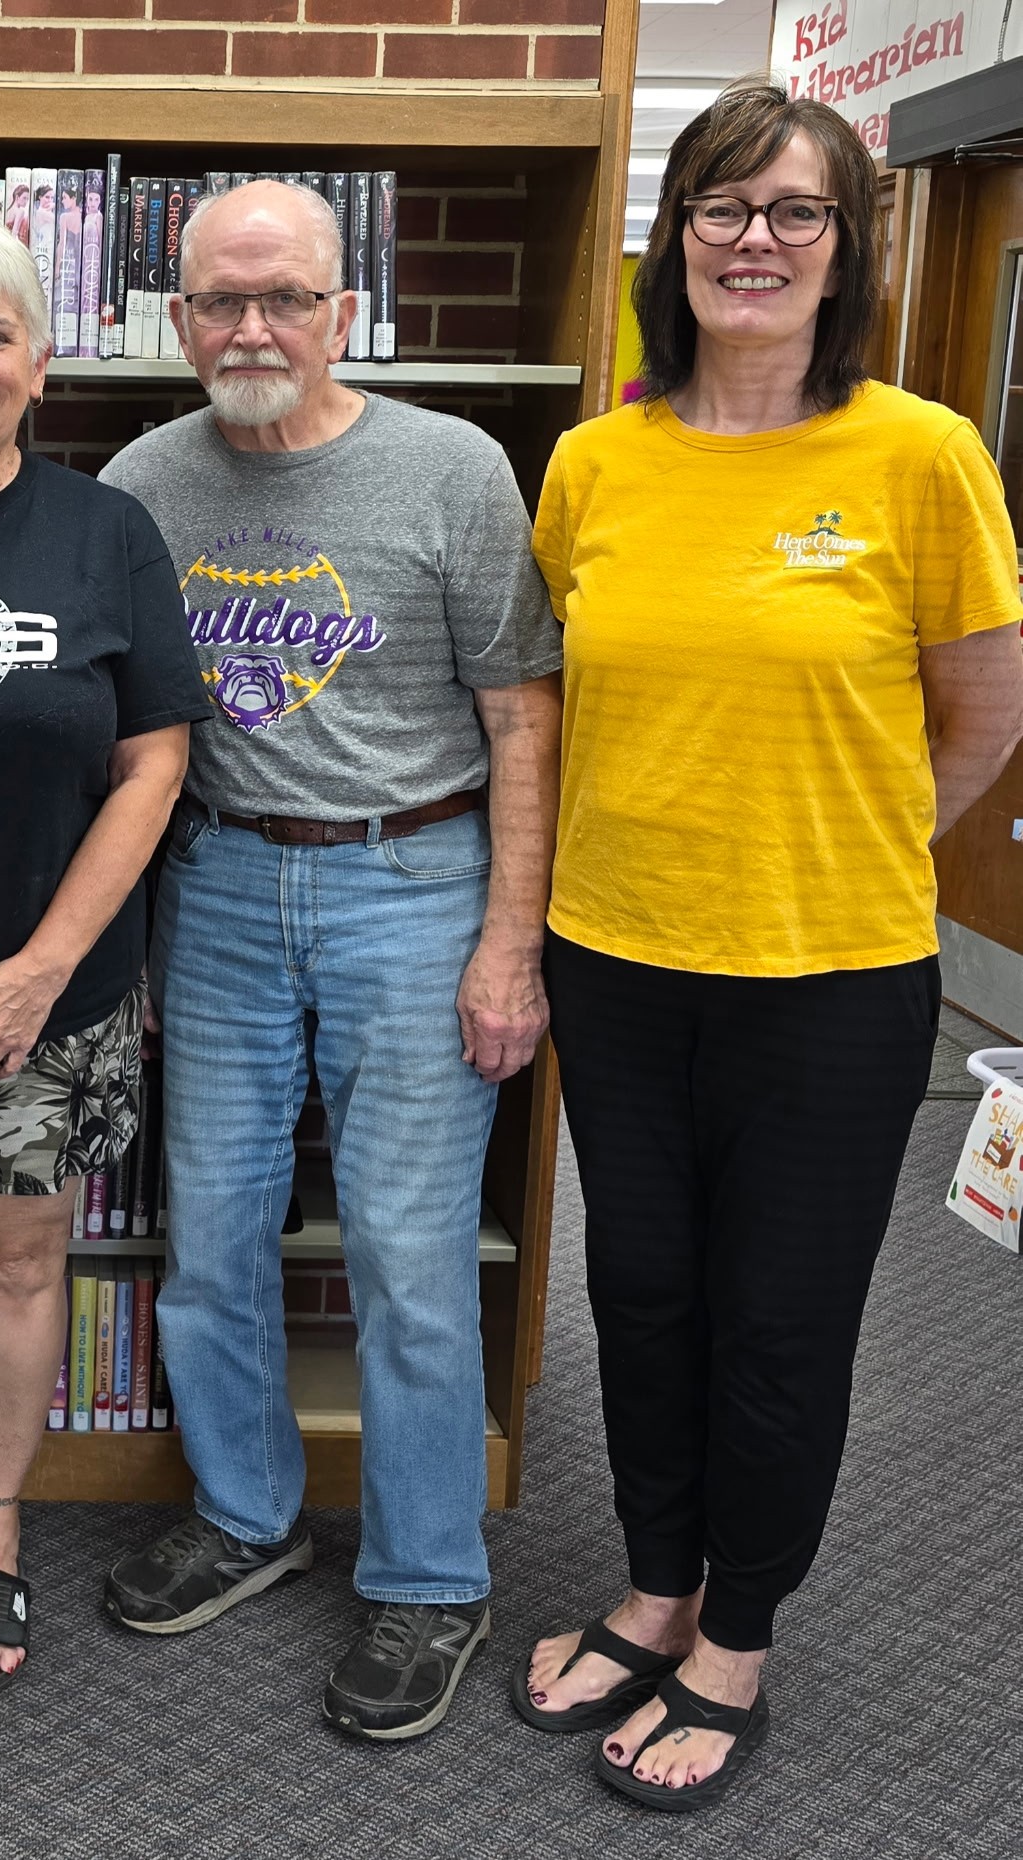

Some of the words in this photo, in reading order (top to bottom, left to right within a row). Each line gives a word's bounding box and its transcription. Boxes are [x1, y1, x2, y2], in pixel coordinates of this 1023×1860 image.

[793, 0, 848, 62] Kid
[789, 11, 965, 104] Librarian
[133, 194, 145, 242] MARKED
[148, 199, 162, 264] BETRAYED
[167, 193, 183, 255] CHOSEN
[359, 193, 369, 240] REVEALED
[57, 259, 76, 312] HEIR
[83, 244, 100, 314] CROWN
[204, 528, 249, 559] LAKE
[263, 528, 320, 557] MILLS
[773, 532, 812, 550] Here
[813, 531, 866, 550] Comes
[785, 550, 814, 566] The
[814, 550, 846, 566] Sun
[183, 593, 386, 668] ulldogs
[992, 1167, 1018, 1194] CARE
[79, 1314, 87, 1333] HOW
[79, 1334, 86, 1345] TO
[138, 1302, 149, 1347] BONES
[78, 1347, 86, 1363] LIVE
[100, 1341, 108, 1363] HUDA
[77, 1365, 85, 1398] WITHOUT
[120, 1369, 128, 1383] ARE
[135, 1364, 147, 1406] SAINT
